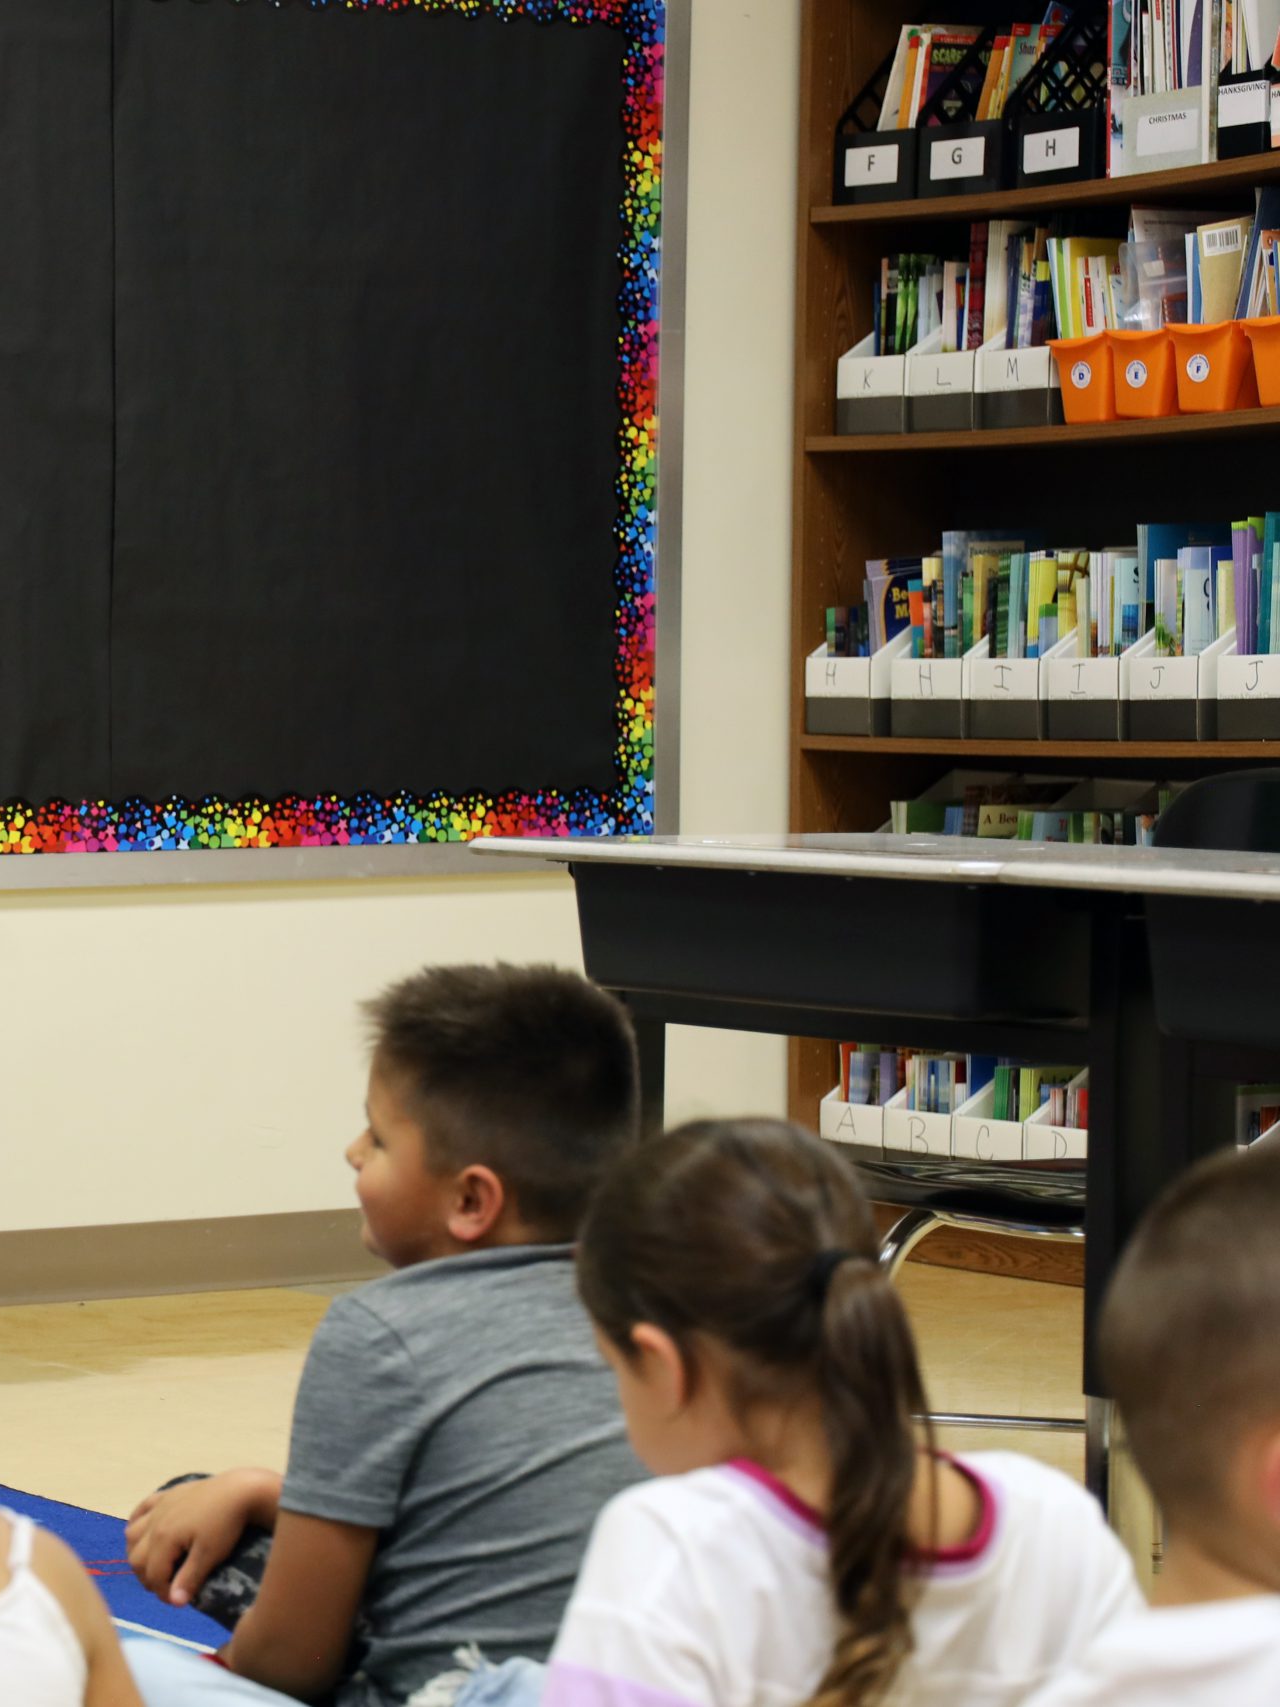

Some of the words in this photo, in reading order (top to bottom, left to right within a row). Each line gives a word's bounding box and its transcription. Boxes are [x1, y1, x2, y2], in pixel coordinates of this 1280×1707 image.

[1220, 82, 1266, 95] HANKSGIVING
[1149, 112, 1187, 125] CHRISTMAS
[951, 147, 963, 165] G
[1045, 140, 1056, 158] H
[867, 155, 875, 172] F
[863, 369, 871, 388] K
[936, 367, 951, 386] L
[1007, 357, 1019, 382] M
[825, 662, 835, 686] H
[920, 664, 933, 697] H
[1150, 667, 1165, 689] J
[1245, 660, 1264, 691] J
[836, 1106, 855, 1135] A
[909, 1117, 929, 1154] B
